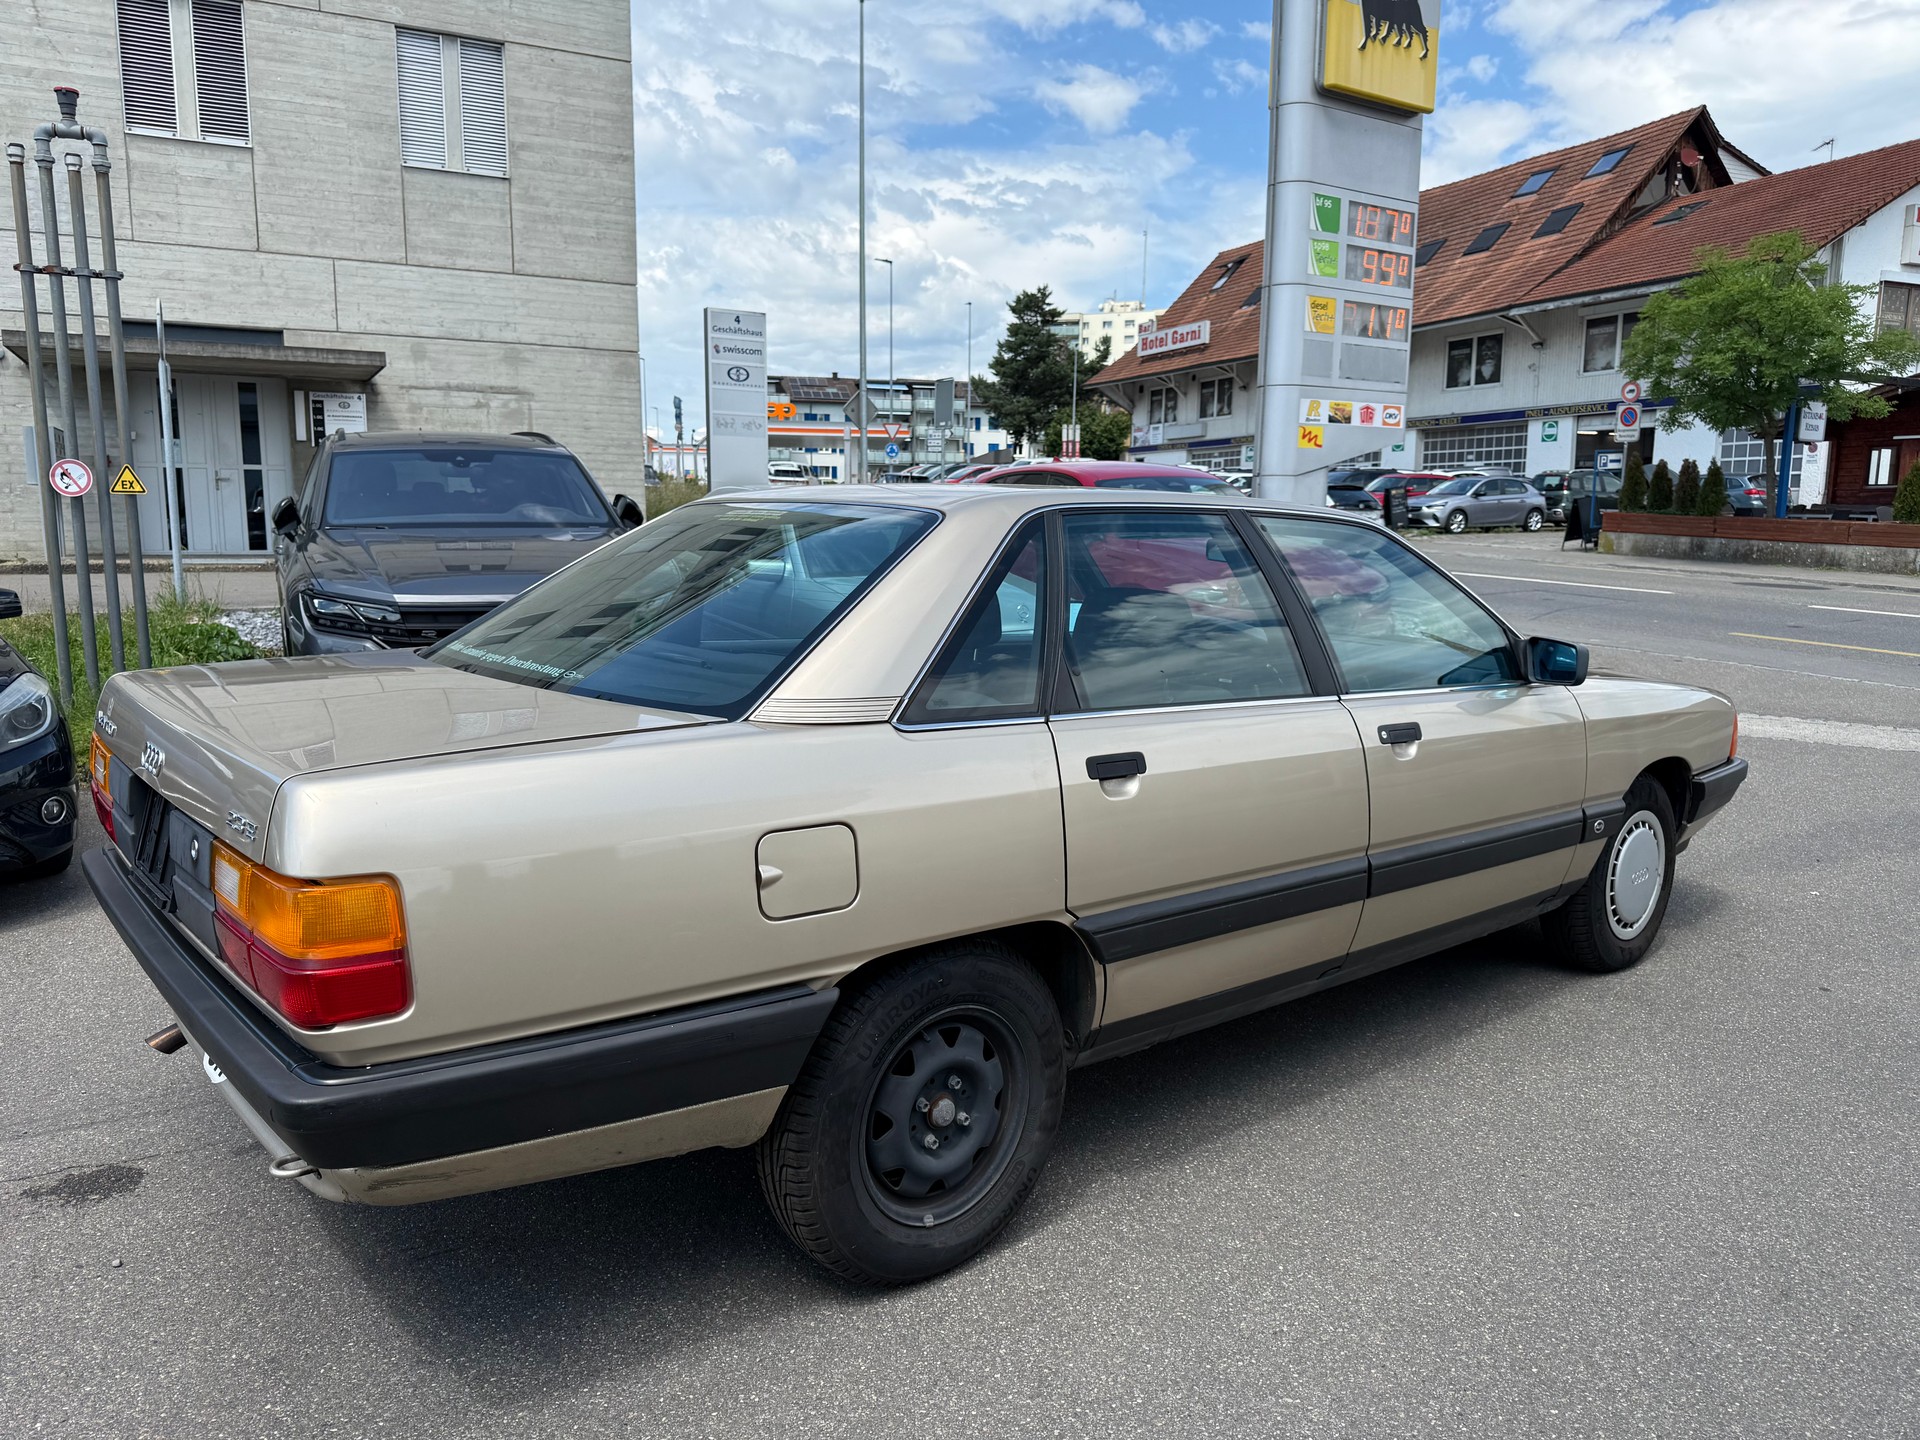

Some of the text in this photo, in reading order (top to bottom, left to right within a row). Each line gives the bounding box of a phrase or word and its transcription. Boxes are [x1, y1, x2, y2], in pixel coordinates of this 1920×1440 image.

[1310, 300, 1329, 312] diesel
[734, 315, 741, 325] 4
[712, 325, 763, 337] Geschäftshaus
[1141, 325, 1202, 352] Hotel Garni
[722, 345, 763, 356] swisscom
[121, 480, 135, 490] EX
[502, 655, 565, 677] Durchrostung
[857, 970, 952, 1063] UNIROYAL
